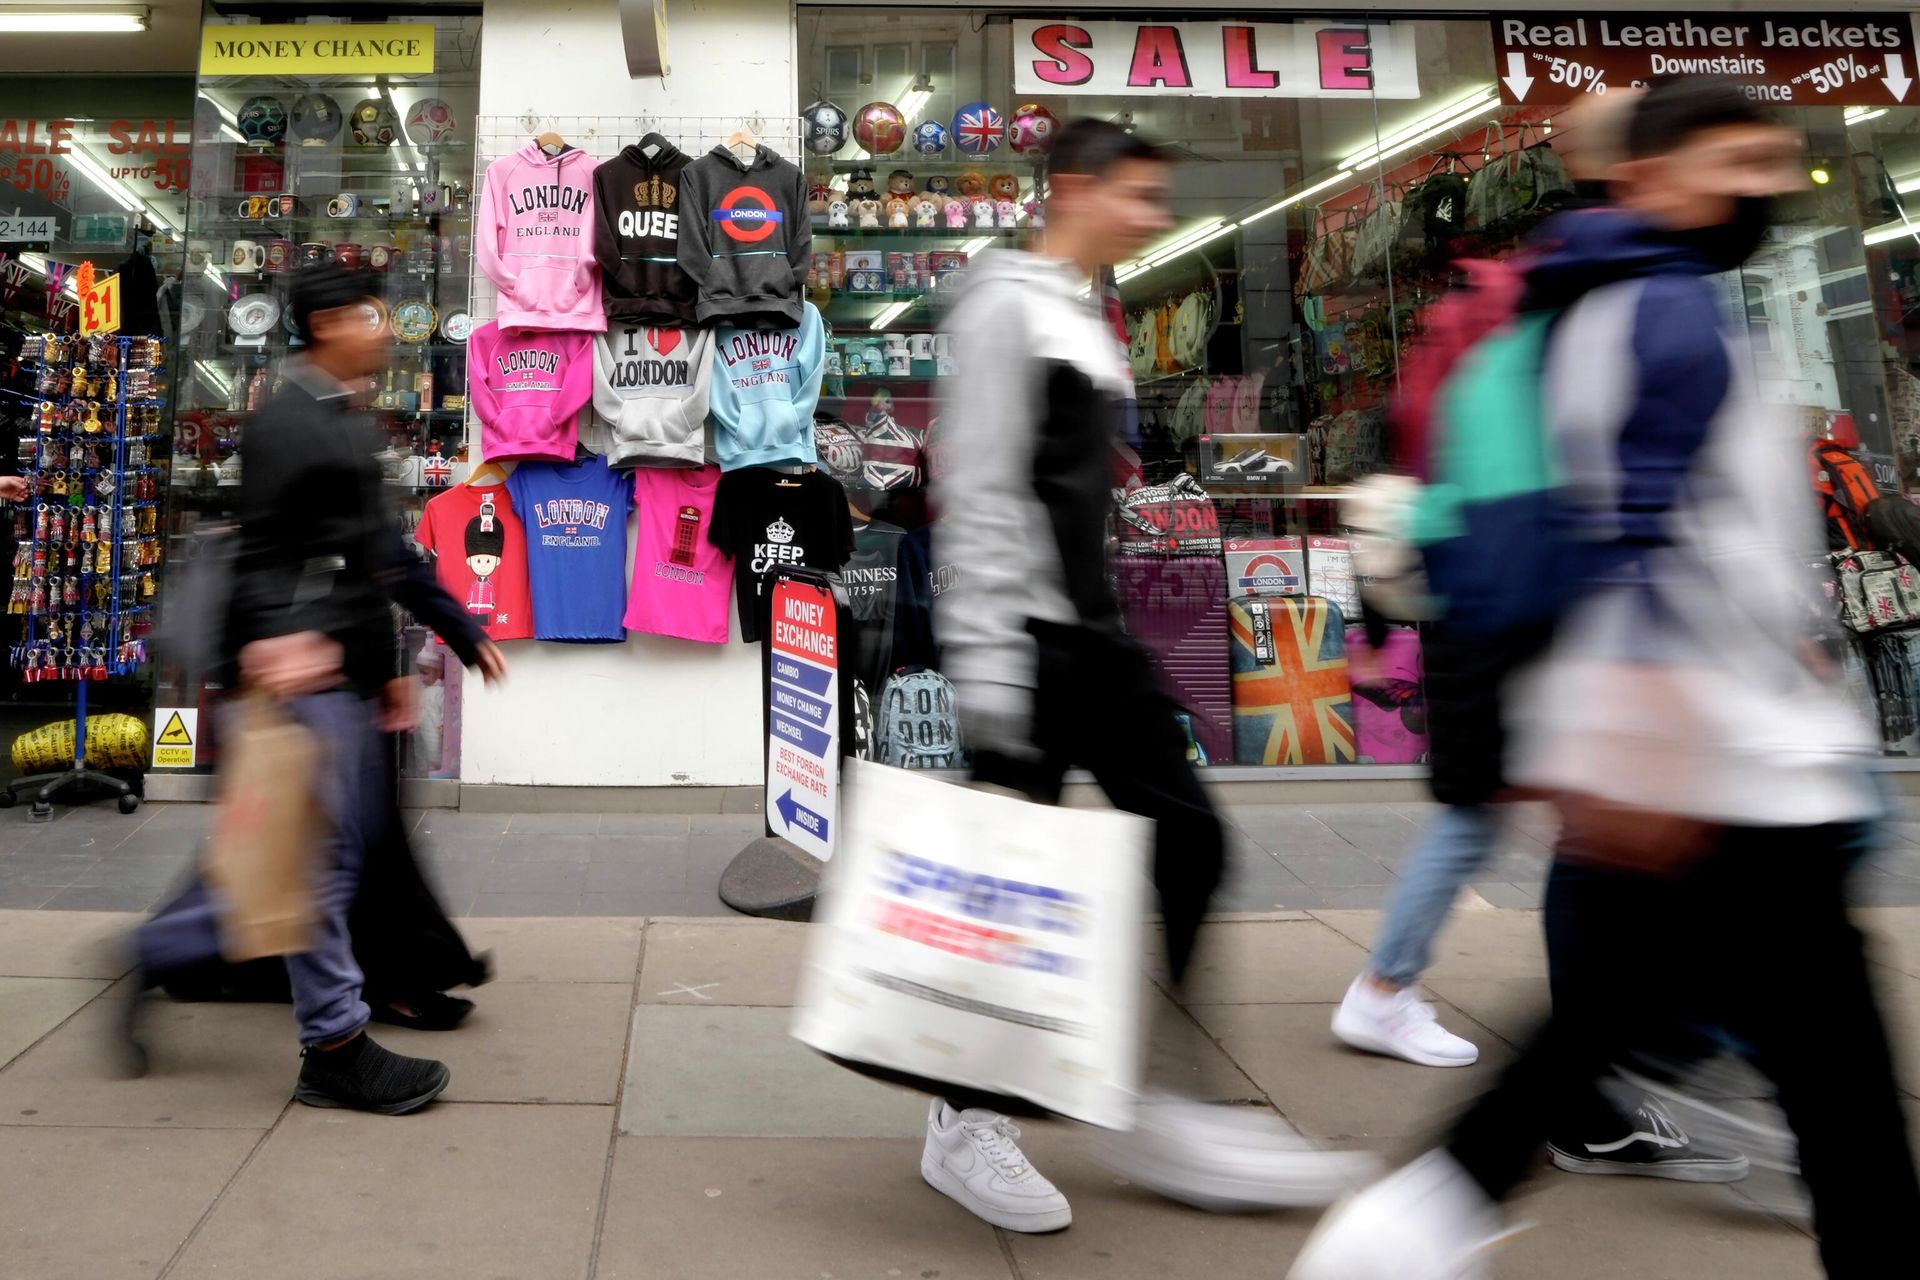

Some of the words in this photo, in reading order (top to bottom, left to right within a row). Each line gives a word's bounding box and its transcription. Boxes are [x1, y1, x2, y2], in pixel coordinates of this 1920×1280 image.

[1502, 18, 1587, 46] Real
[1600, 18, 1749, 47] Leather
[1761, 19, 1901, 47] Jackets
[214, 40, 307, 58] MONEY
[313, 39, 420, 57] CHANGE
[1031, 25, 1374, 90] SALE
[1532, 52, 1544, 61] up
[1544, 54, 1553, 63] to
[1549, 57, 1607, 96] 50%
[1650, 54, 1766, 75] Downstairs
[1791, 76, 1802, 85] up
[1801, 72, 1810, 80] to
[1810, 53, 1868, 94] 50%
[1869, 64, 1881, 74] off
[815, 127, 840, 137] SPURS
[14, 158, 70, 191] 50%
[110, 167, 151, 179] UPTO
[508, 185, 590, 215] LONDON
[730, 209, 768, 219] LONDON
[516, 226, 581, 238] ENGLAND
[618, 210, 677, 240] QUEE
[84, 286, 111, 332] £1
[625, 328, 639, 356] I
[719, 327, 798, 368] LONDON
[497, 349, 560, 376] LONDON
[616, 360, 689, 388] LONDON
[732, 372, 791, 389] ENGLAND
[534, 499, 610, 530] LONDON
[542, 535, 601, 547] ENGLAND
[754, 543, 804, 560] KEEP
[655, 561, 705, 585] LONDON
[1252, 578, 1285, 586] LONDON
[784, 597, 824, 628] MONEY
[776, 621, 834, 659] EXCHANGE
[777, 661, 800, 680] CAMBIO
[776, 690, 797, 711] MONEY
[797, 697, 822, 720] CHANGE
[898, 687, 949, 715] LON
[776, 719, 803, 742] WECHSEL
[157, 755, 190, 764] Operation
[779, 746, 795, 764] BEST
[796, 753, 825, 780] FOREIGN
[775, 762, 808, 789] EXCHANGE
[809, 776, 828, 798] RATE
[796, 807, 819, 833] INSIDE
